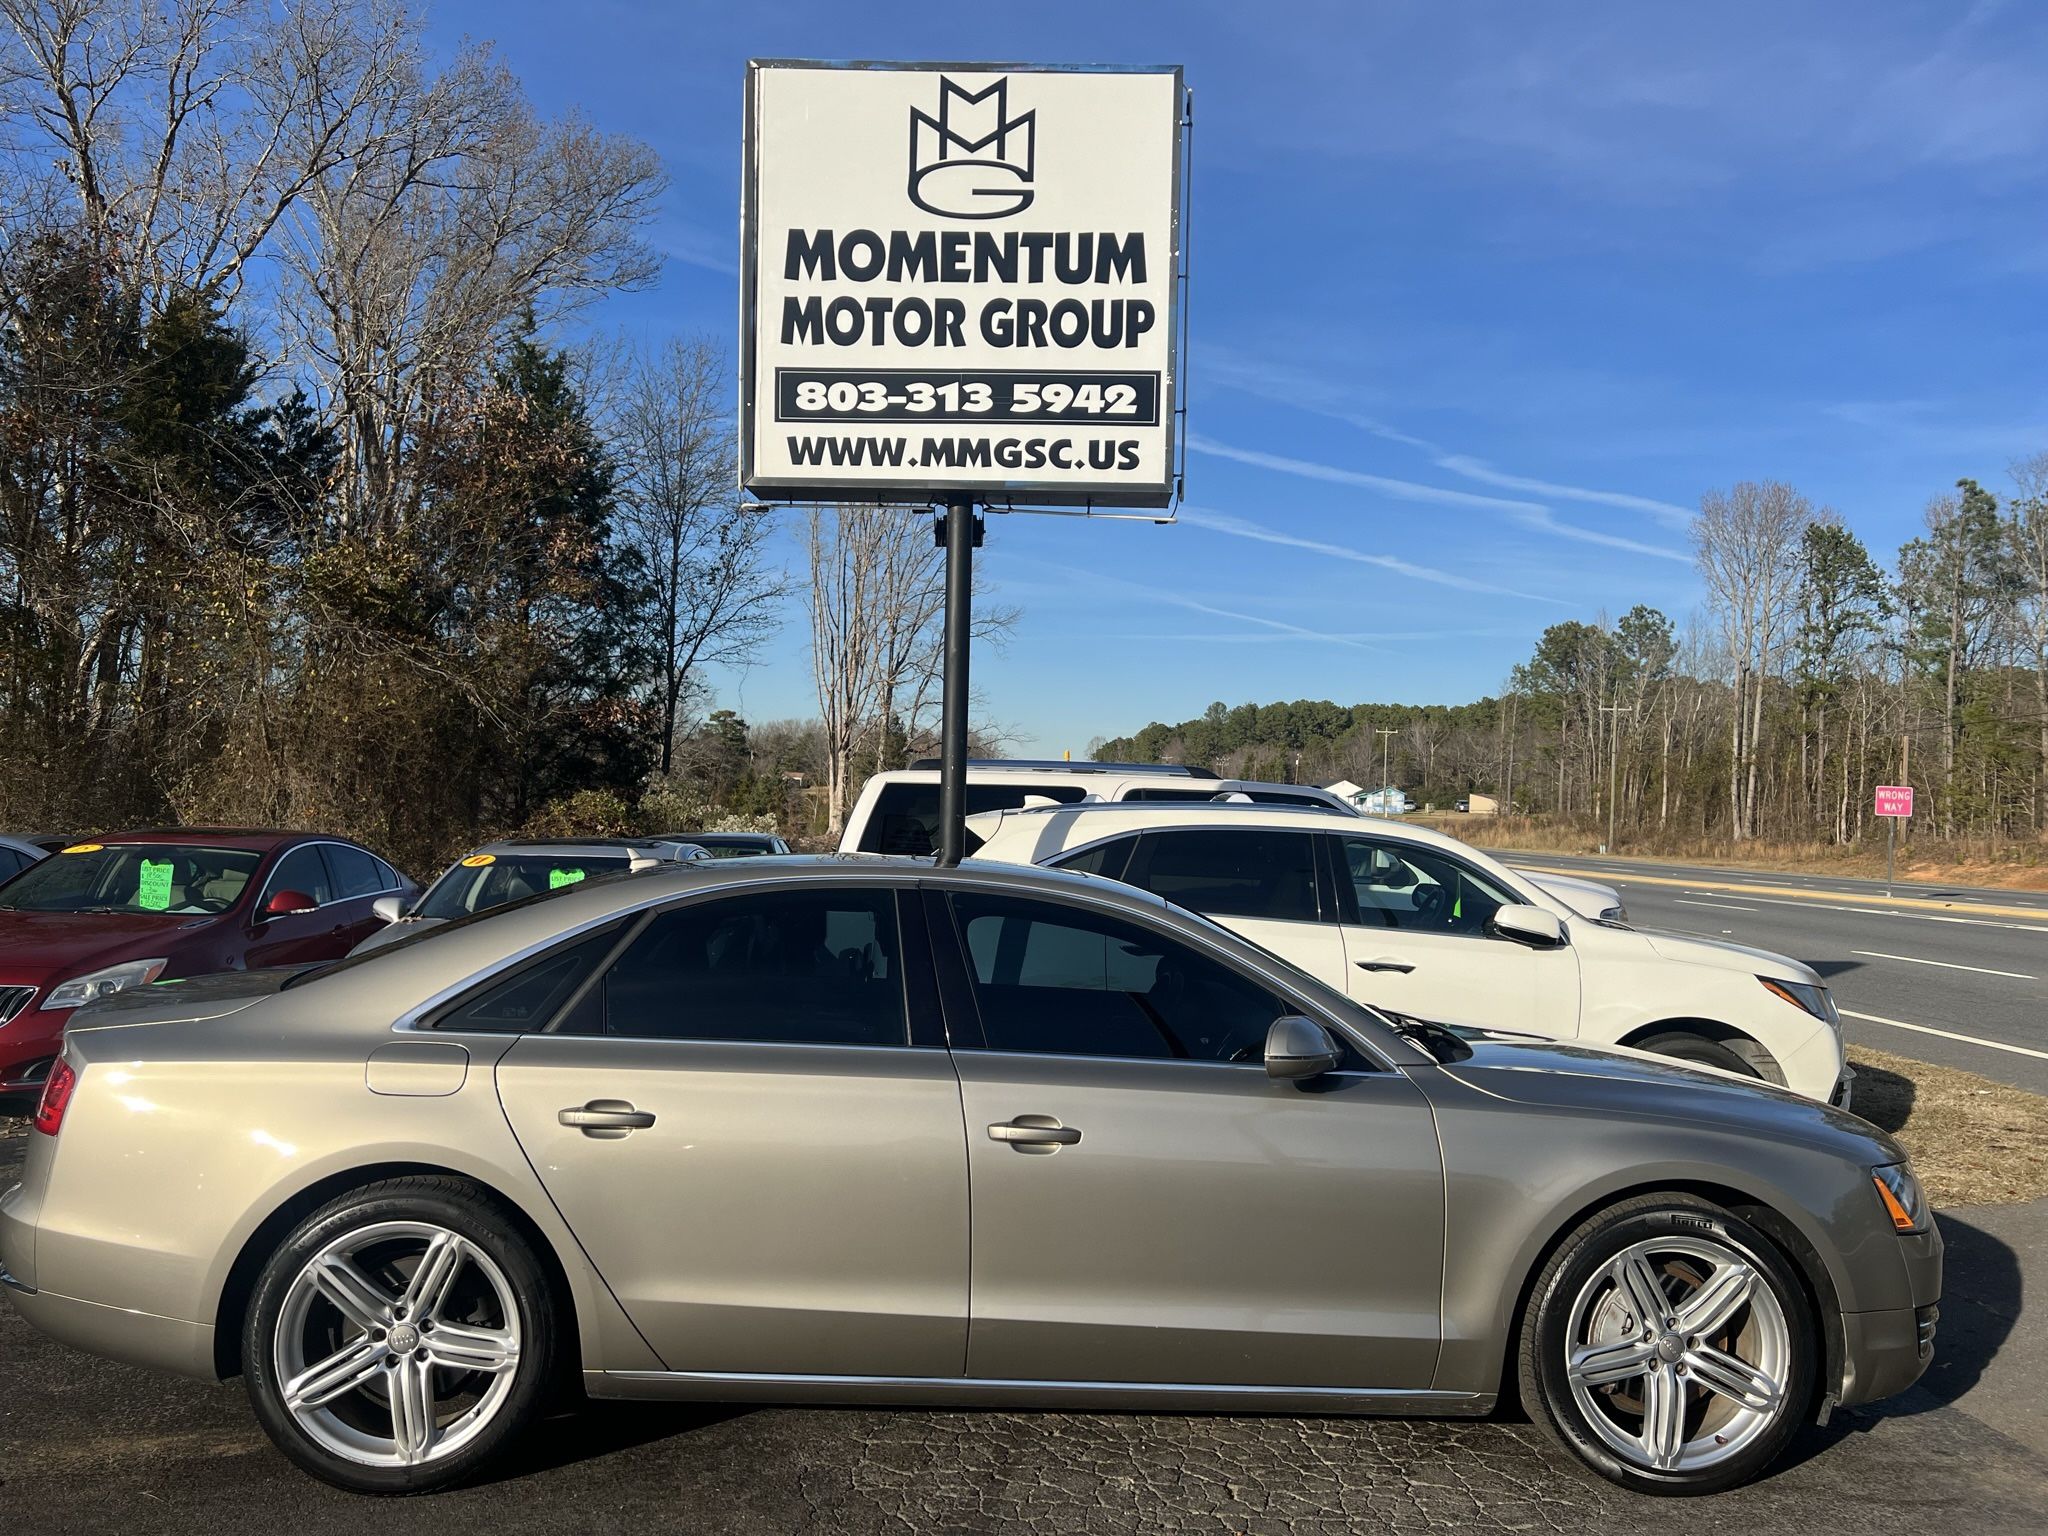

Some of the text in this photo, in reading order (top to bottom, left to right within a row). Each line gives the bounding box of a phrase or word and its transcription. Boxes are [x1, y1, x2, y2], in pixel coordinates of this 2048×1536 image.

[784, 229, 1147, 284] MOMENTUM
[781, 296, 1155, 349] MOTOR GROUP
[796, 382, 1137, 413] 803-313 5942
[787, 437, 1139, 470] WWW.MMGSC.US
[1878, 791, 1910, 800] WRONG
[1884, 803, 1902, 811] WAY
